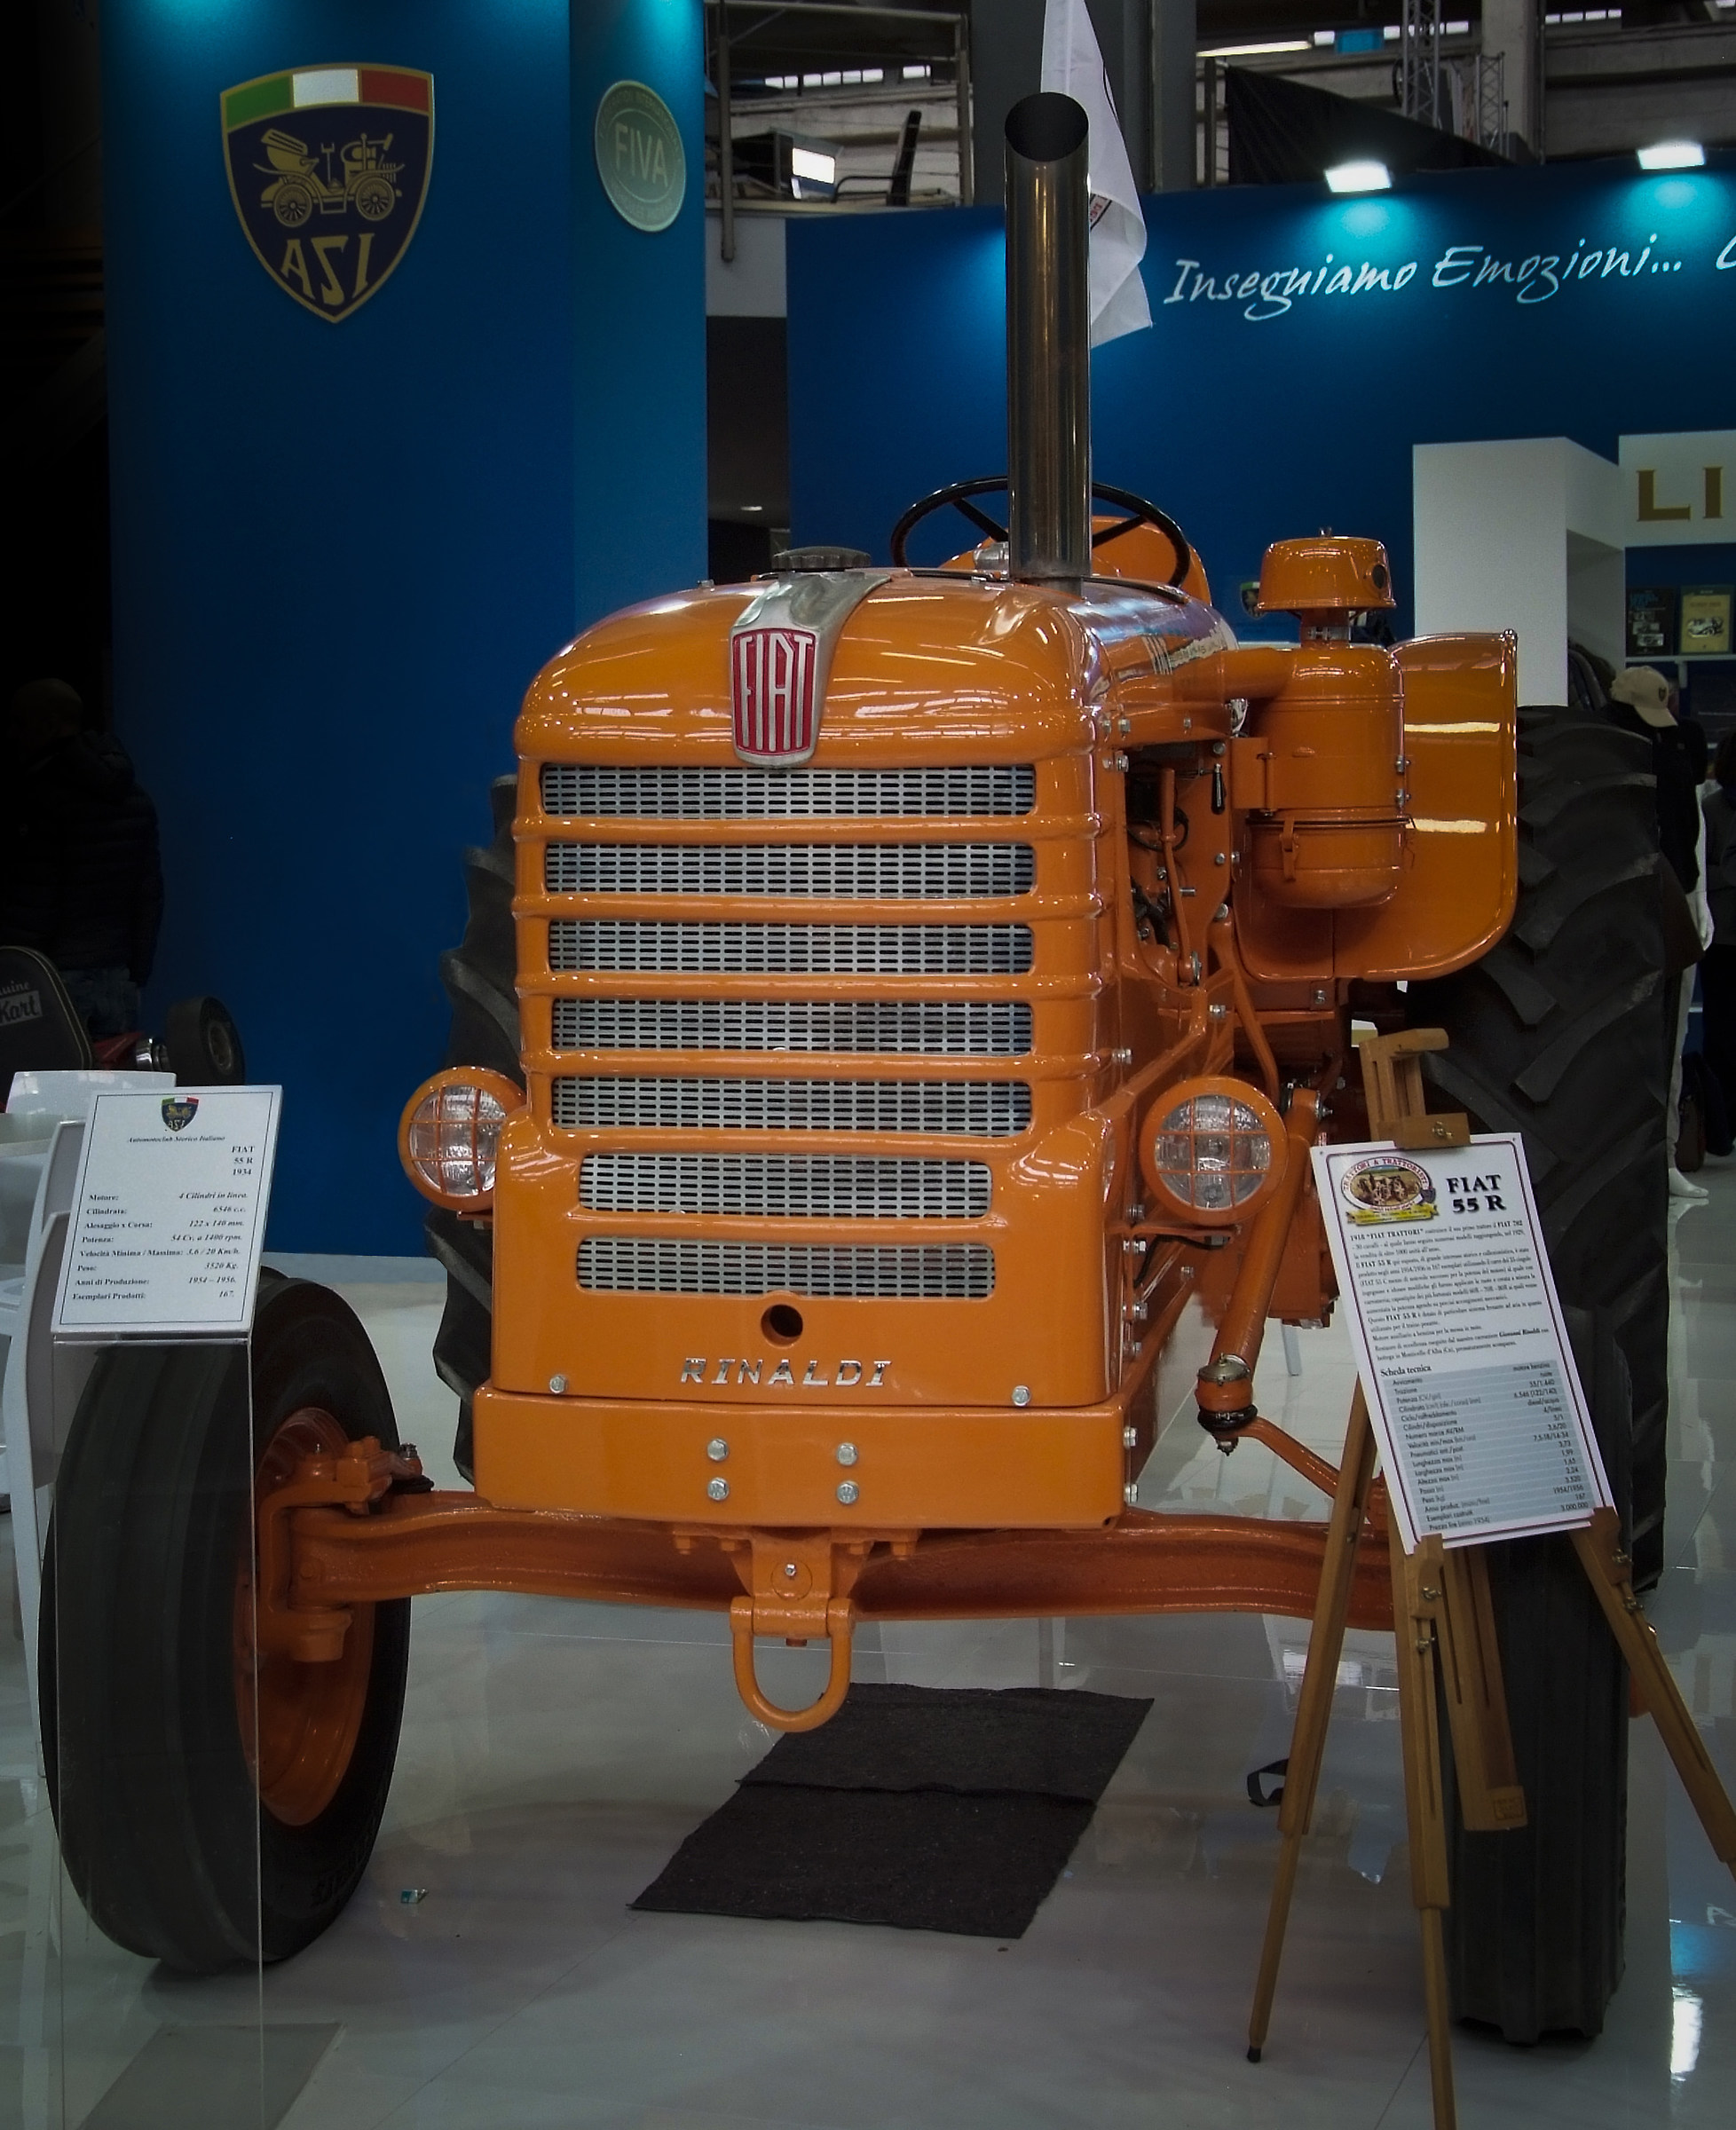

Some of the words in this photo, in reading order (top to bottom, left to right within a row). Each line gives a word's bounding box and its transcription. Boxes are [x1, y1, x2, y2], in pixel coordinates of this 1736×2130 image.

[615, 122, 667, 187] FIVA
[280, 233, 375, 307] ASI
[1164, 254, 1416, 320] Inseguiamo
[1432, 234, 1683, 303] Emozioni...
[1637, 467, 1723, 521] LI
[740, 633, 813, 752] FIAT
[0, 980, 29, 995] uine
[1447, 1174, 1502, 1193] FIAT
[1452, 1196, 1480, 1213] 55
[1485, 1195, 1507, 1211] R
[680, 1357, 892, 1387] RINALDI
[1380, 1366, 1405, 1377] Scheda
[1406, 1363, 1431, 1374] tecnica
